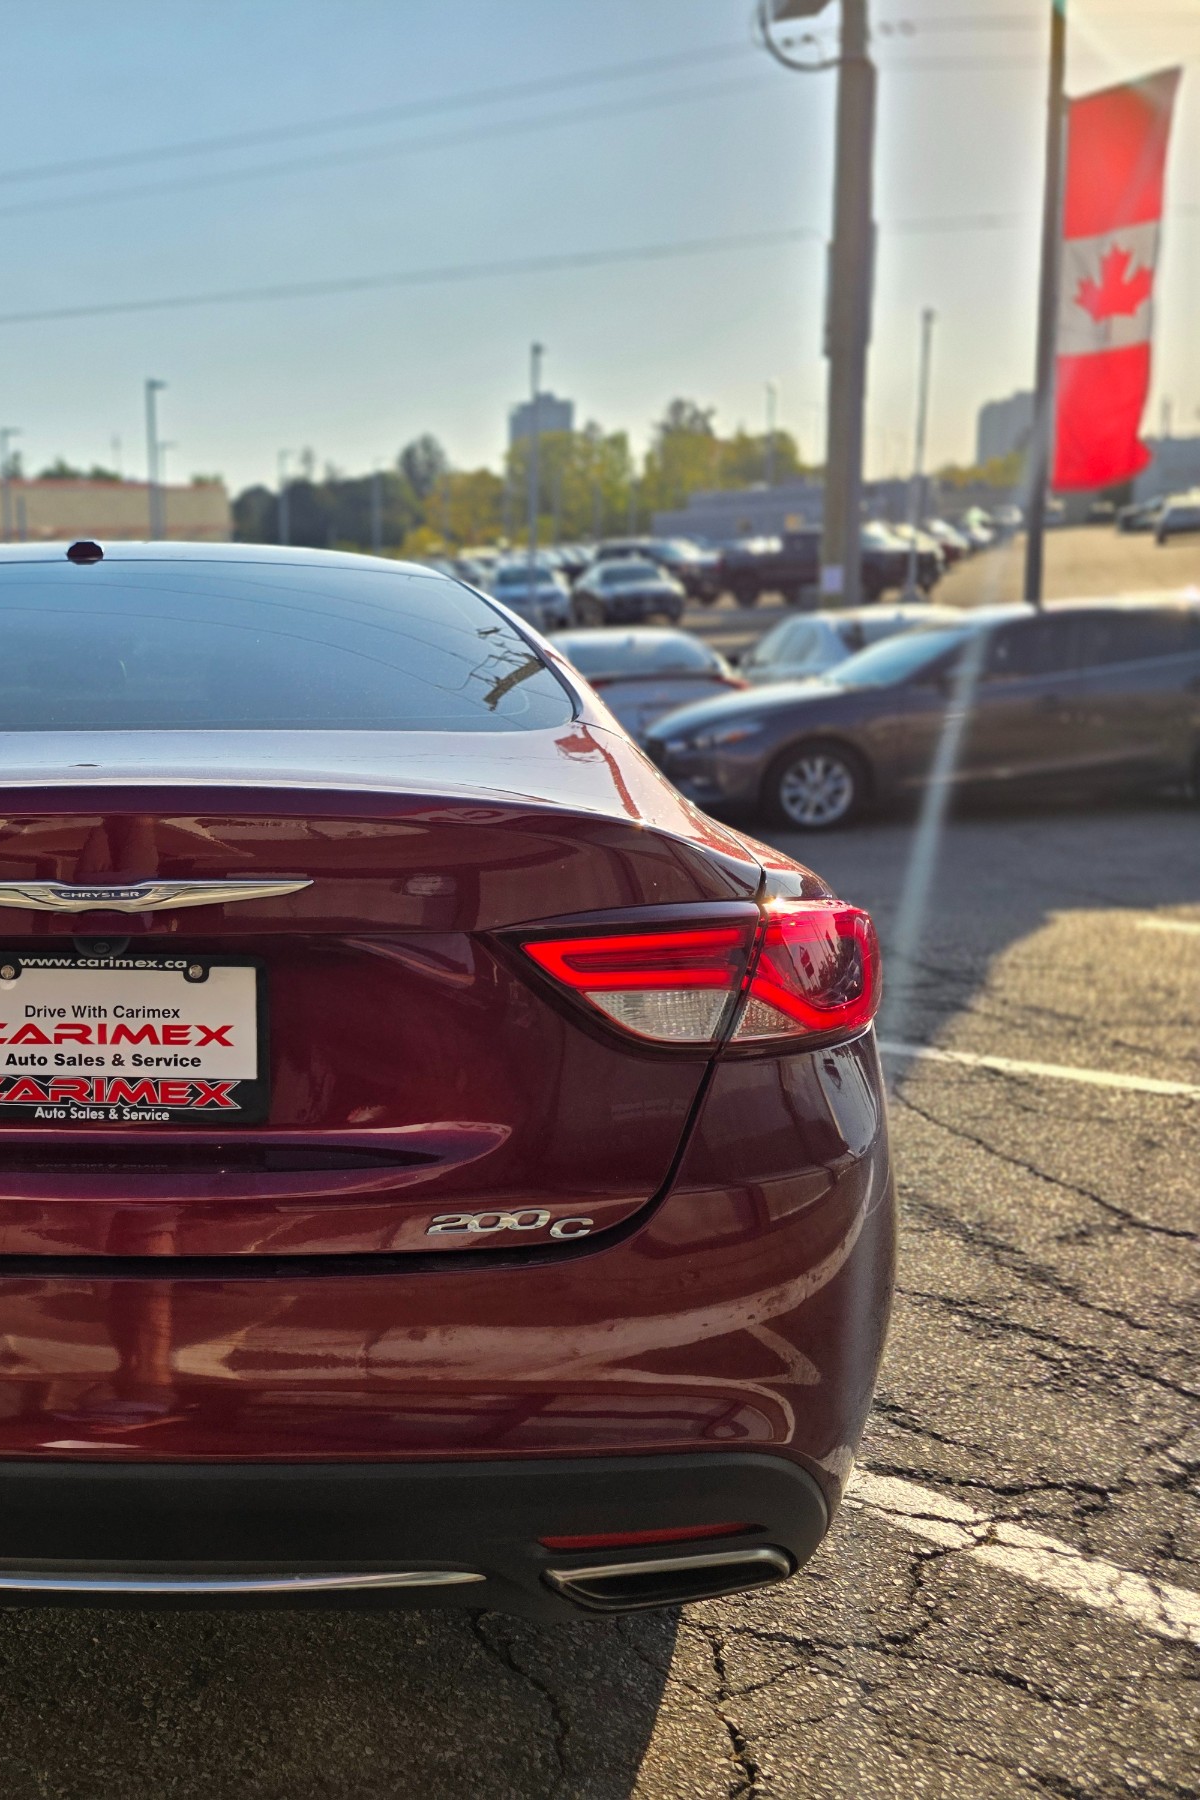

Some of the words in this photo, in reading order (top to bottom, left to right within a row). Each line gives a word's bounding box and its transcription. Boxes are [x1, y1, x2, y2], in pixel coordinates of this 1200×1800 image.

[18, 957, 188, 969] www.carimex.ca
[24, 1004, 67, 1019] Drive
[71, 1004, 108, 1019] With
[112, 1005, 181, 1019] Carimex
[5, 1053, 48, 1067] Auto
[54, 1053, 105, 1067] Sales
[111, 1053, 126, 1067] &
[131, 1054, 202, 1067] Service
[34, 1106, 66, 1119] Auto
[70, 1107, 105, 1120] Sales
[108, 1108, 120, 1120] &
[122, 1108, 170, 1121] Service
[426, 1209, 551, 1236] 200
